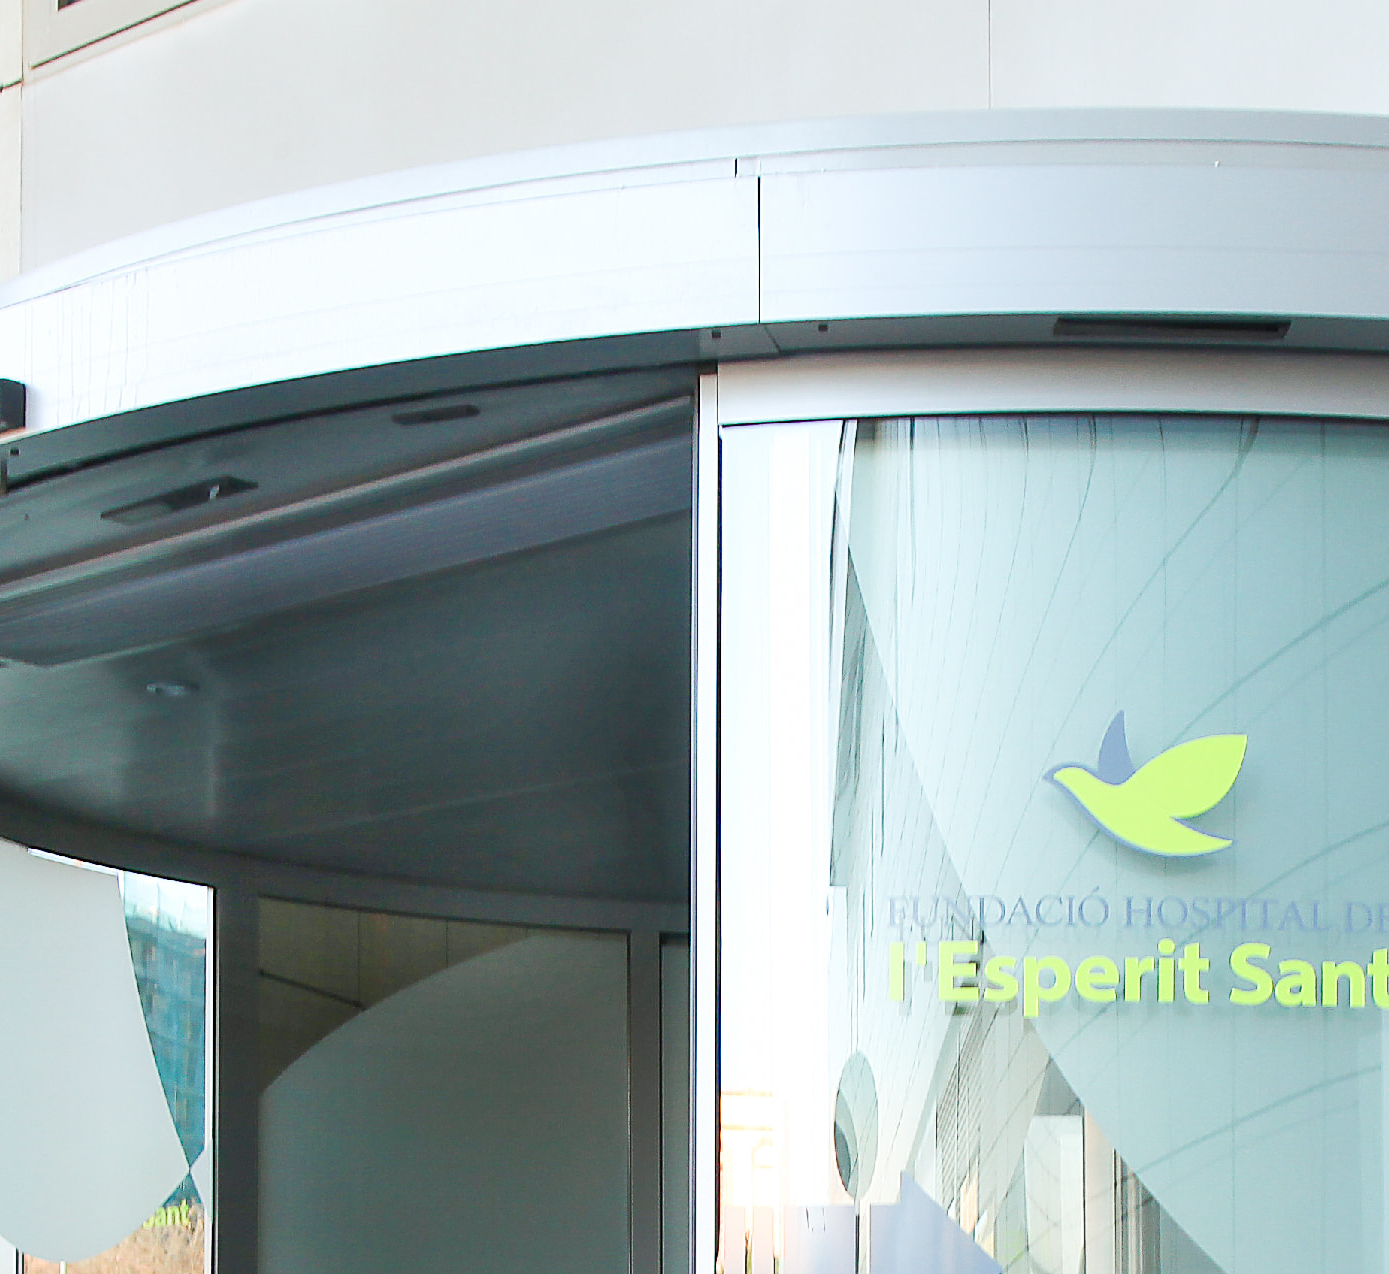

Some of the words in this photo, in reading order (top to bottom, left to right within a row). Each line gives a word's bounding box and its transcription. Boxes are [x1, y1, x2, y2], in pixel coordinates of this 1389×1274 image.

[887, 886, 1110, 930] FUNDACIÓ
[1124, 895, 1330, 933] HOSPITAL
[888, 938, 1210, 1018] l'Esperit
